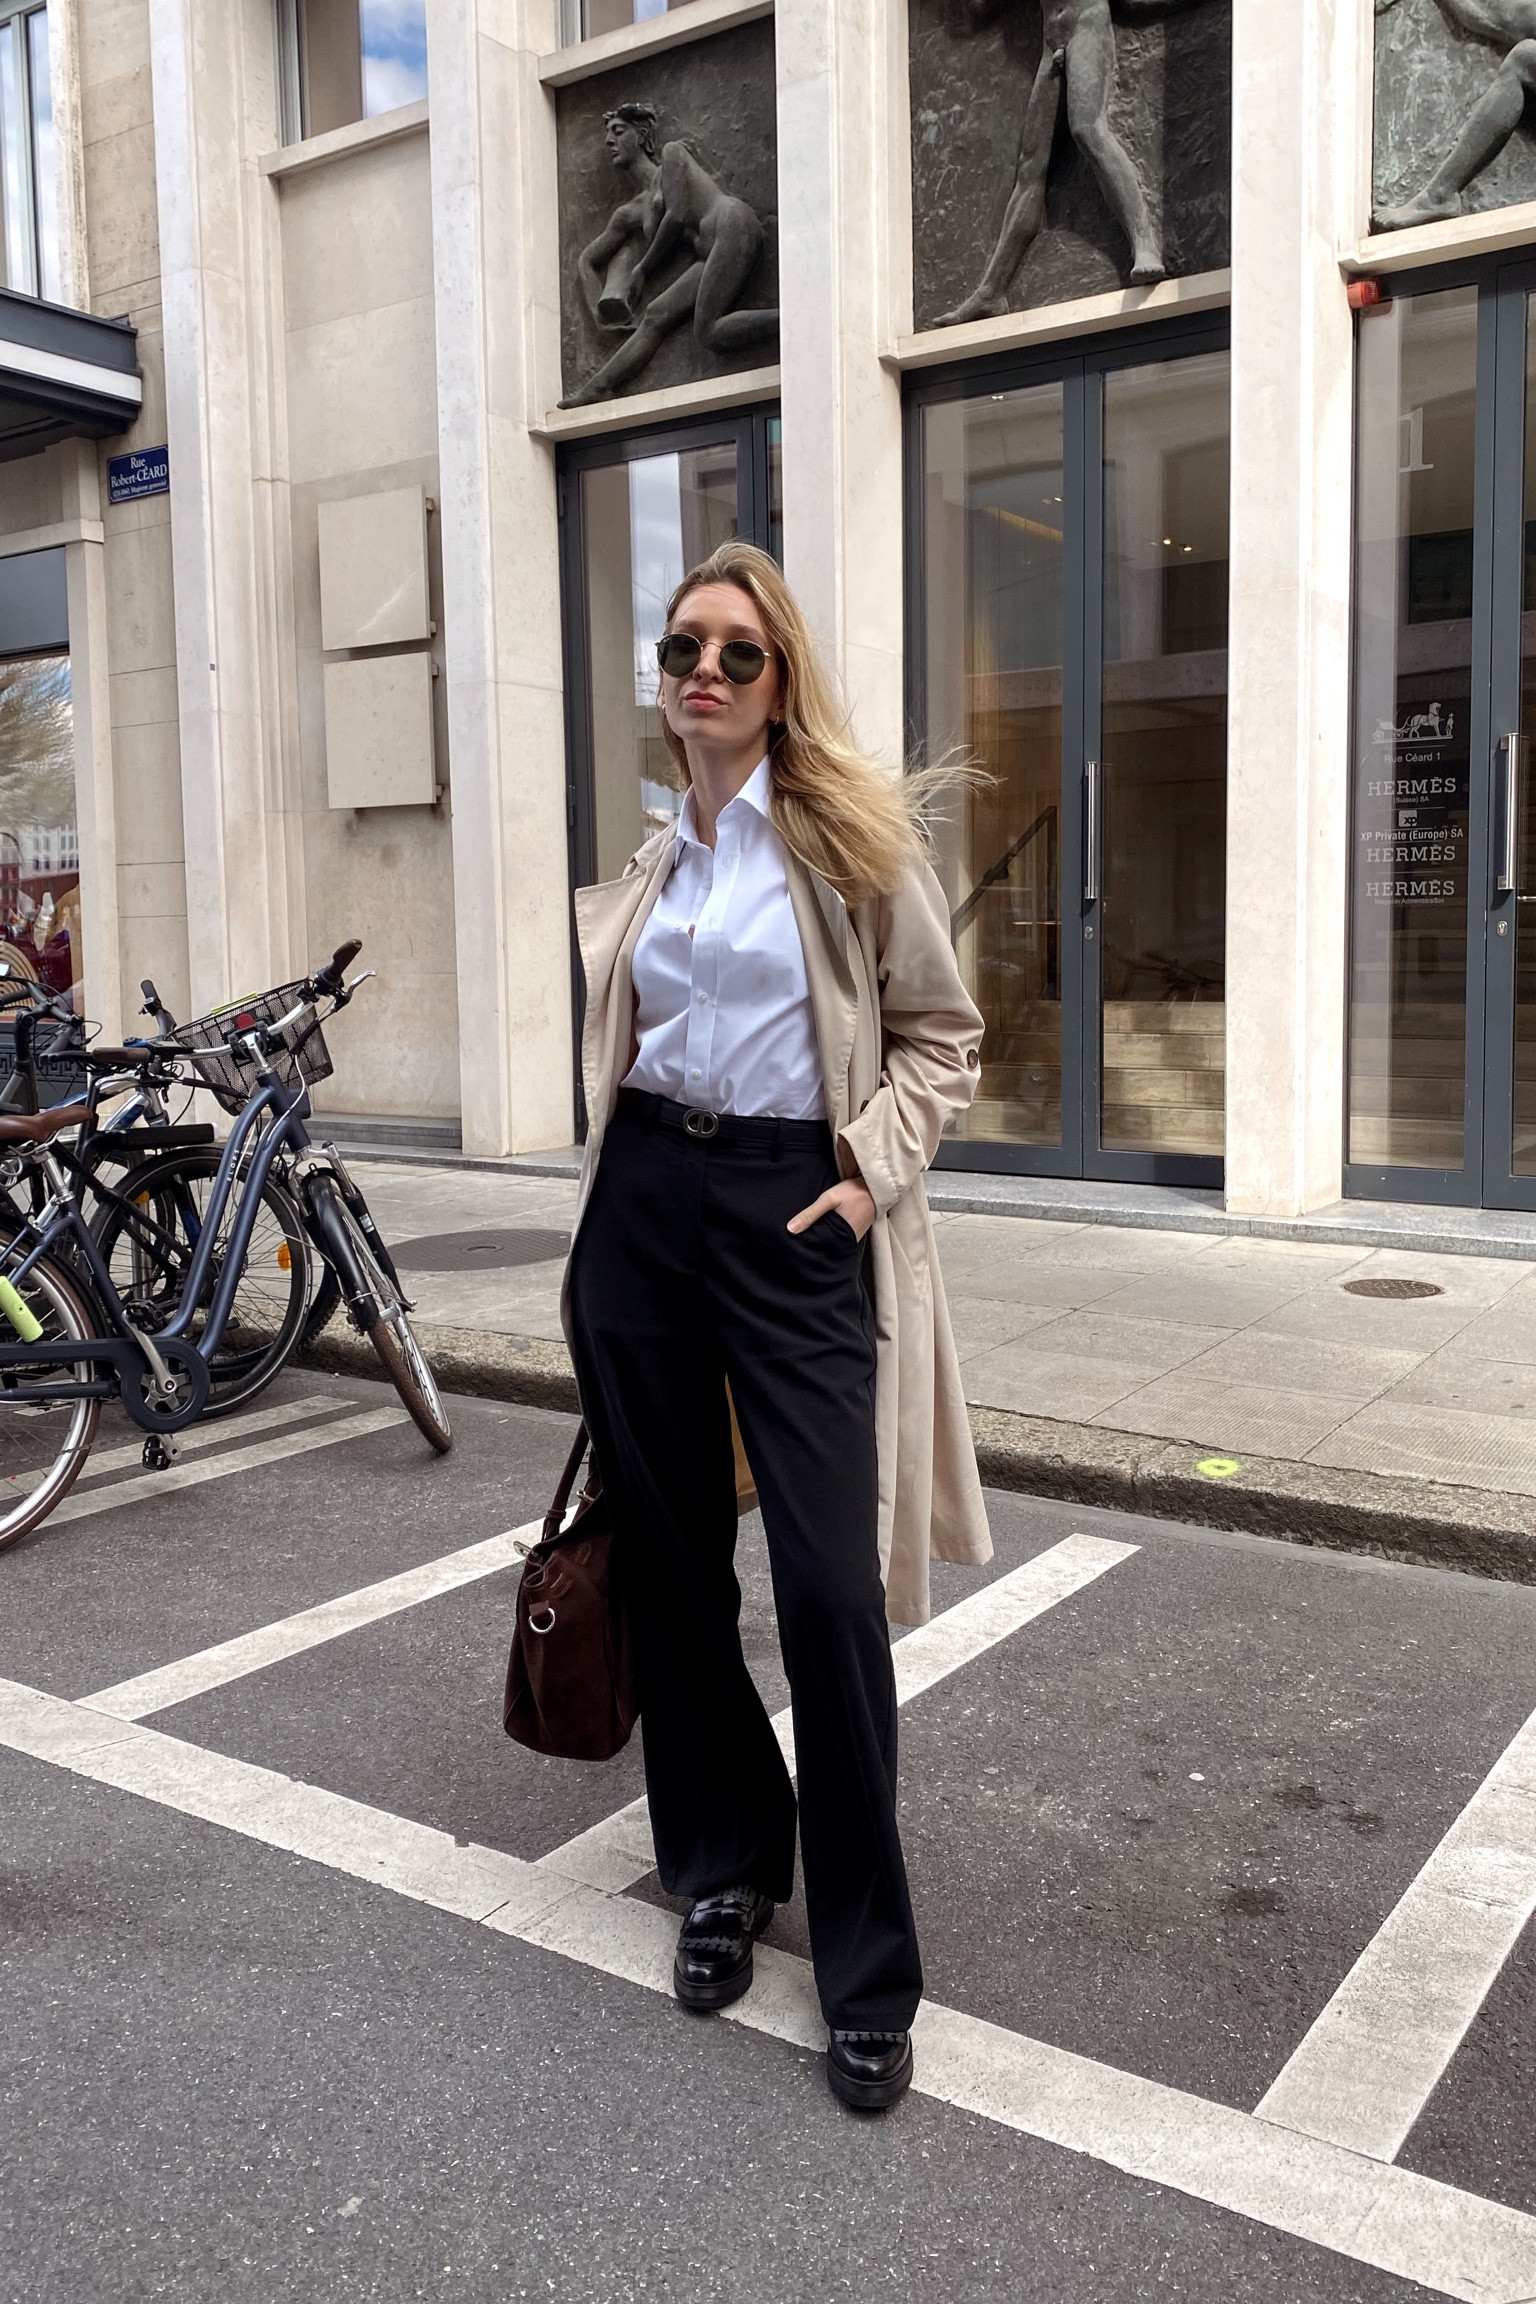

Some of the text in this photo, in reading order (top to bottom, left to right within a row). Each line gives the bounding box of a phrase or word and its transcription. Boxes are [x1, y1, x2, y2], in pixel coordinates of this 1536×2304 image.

[130, 456, 146, 469] Rue
[110, 464, 168, 488] Robert-CÉARD
[1384, 751, 1441, 763] Rue Céard 1
[1367, 777, 1456, 796] HERMÈS
[1360, 828, 1464, 841] XP Private (Europe) SA
[1366, 845, 1455, 862] HERMÈS
[1365, 880, 1455, 896] HERMÈS
[226, 1149, 240, 1182] ELOPS
